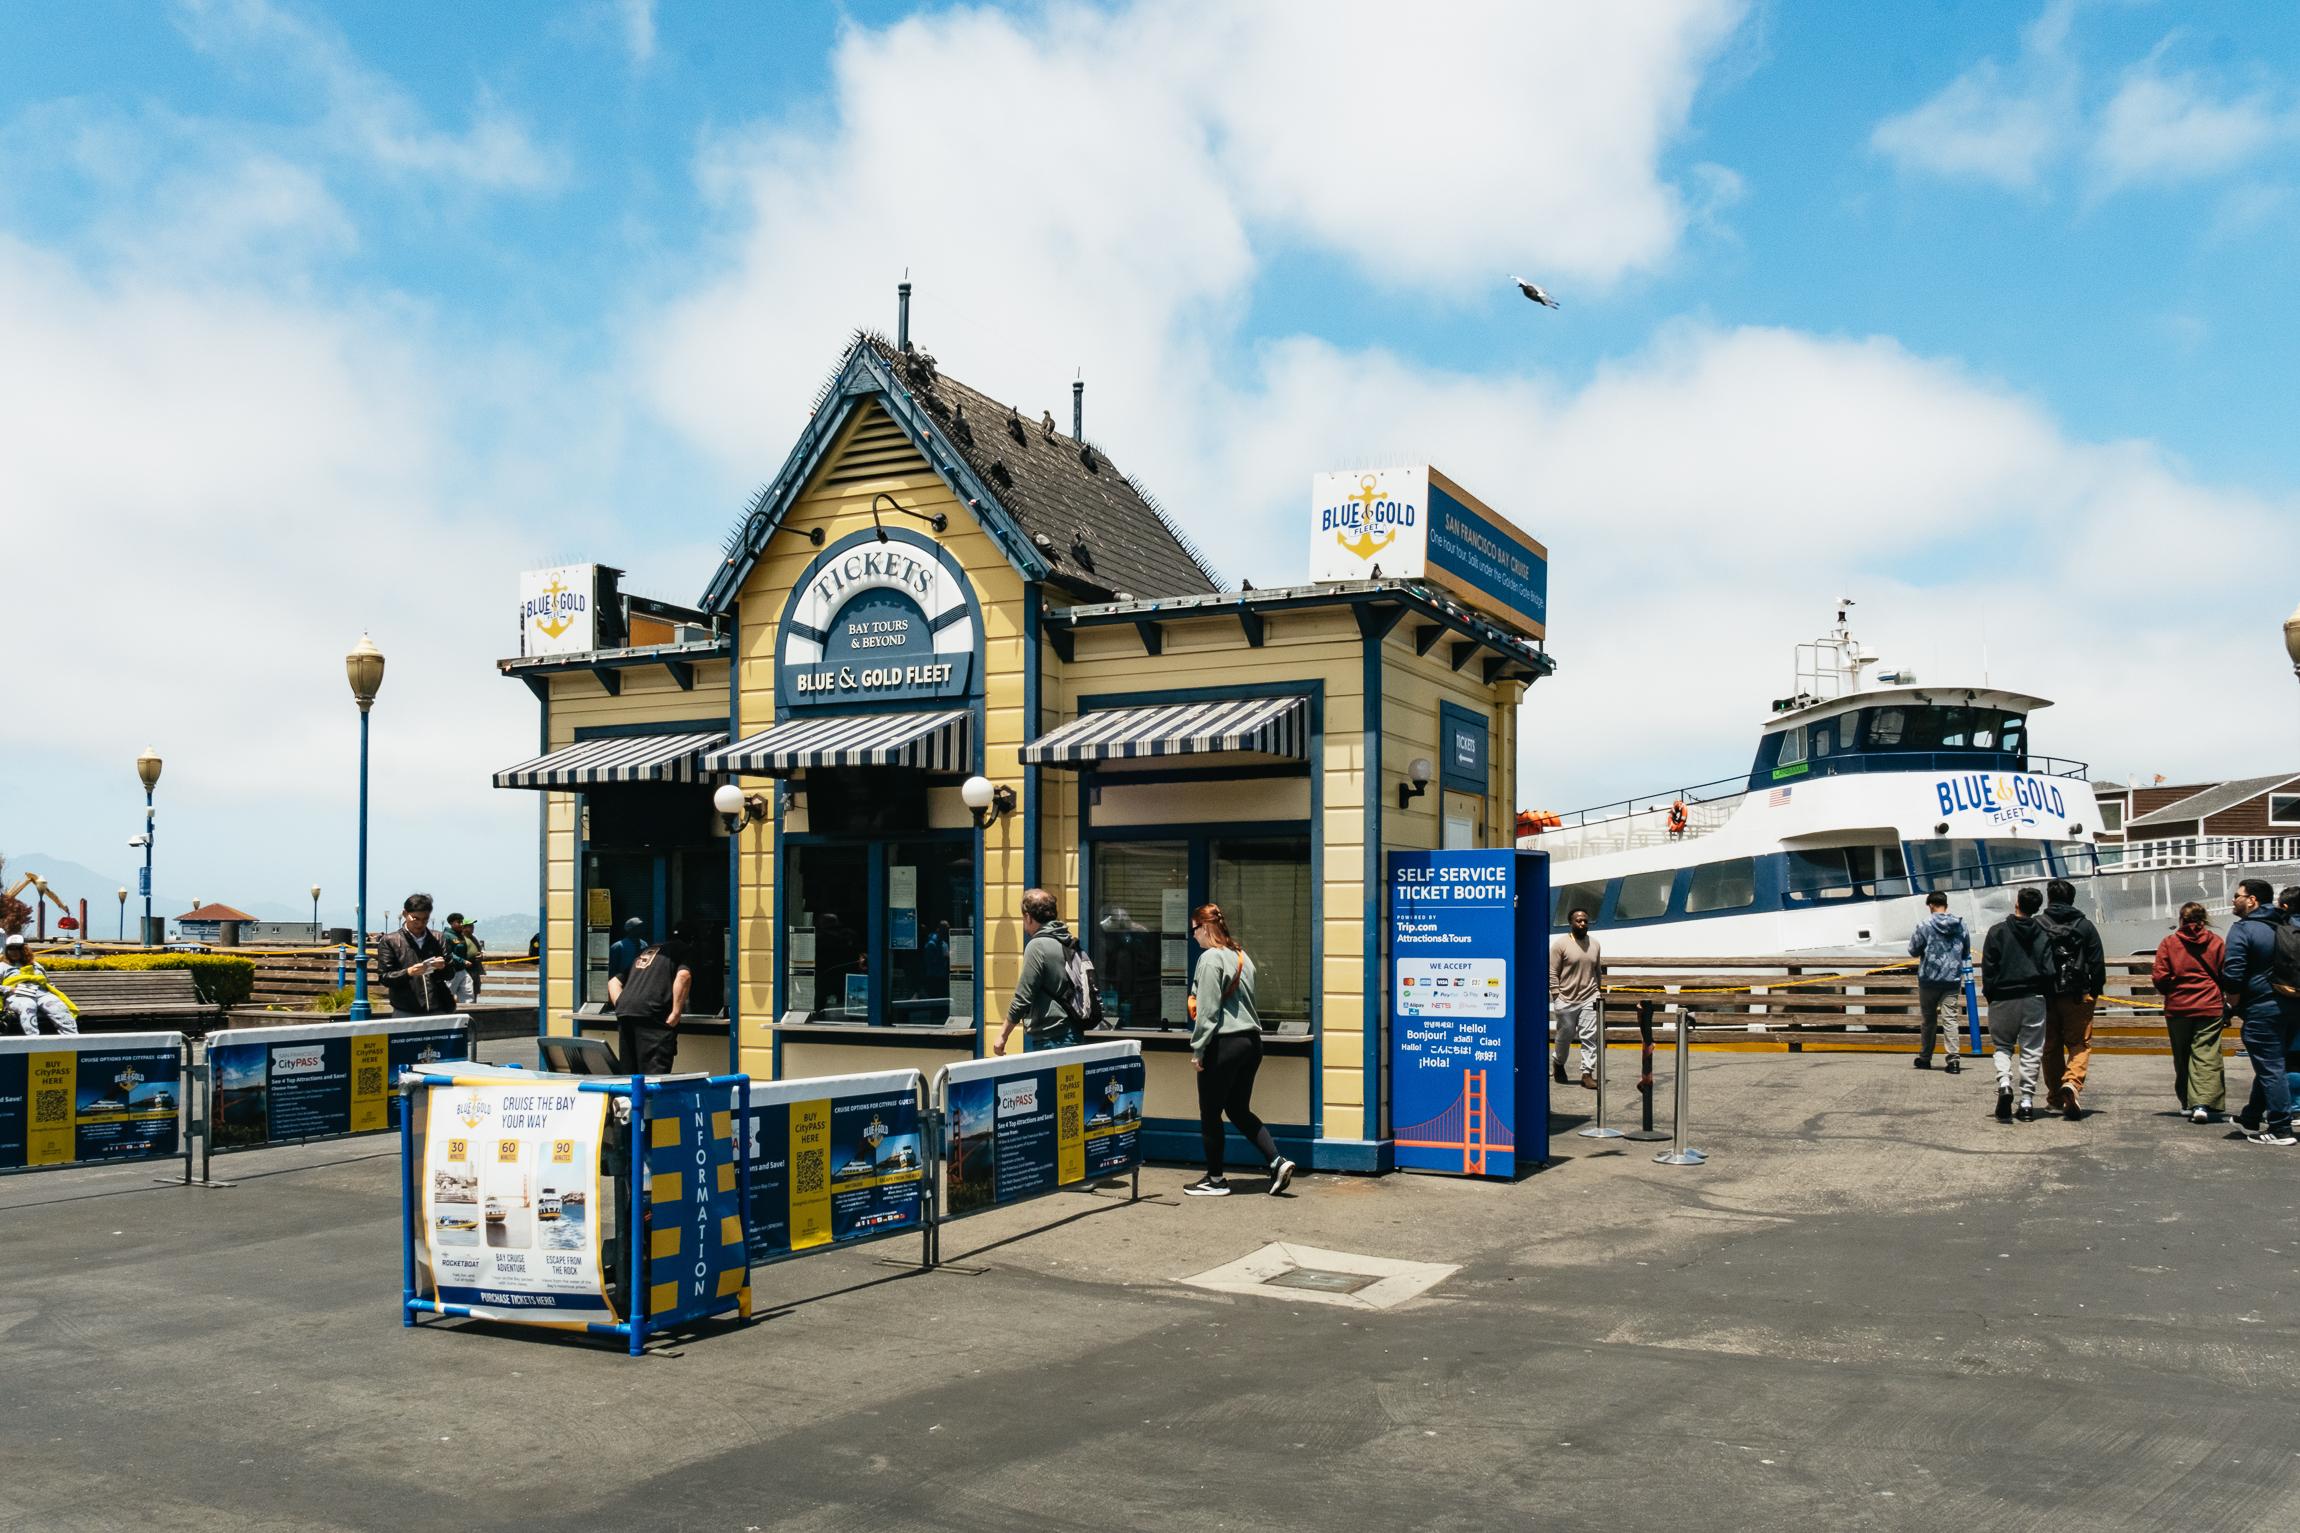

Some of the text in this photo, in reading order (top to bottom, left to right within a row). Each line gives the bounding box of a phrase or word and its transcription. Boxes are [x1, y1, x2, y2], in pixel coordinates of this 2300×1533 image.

[1322, 503, 1360, 531] BLUE
[1375, 501, 1415, 527] GOLD
[1354, 523, 1378, 534] FLEET
[1445, 513, 1529, 580] SAN FRANCISCO BAY CRUISE
[1430, 528, 1442, 547] One
[1443, 537, 1456, 554] hour
[1456, 546, 1467, 562] tour.
[1468, 551, 1479, 569] Sails
[1480, 561, 1493, 577] under
[1502, 573, 1519, 592] Golden
[1519, 584, 1530, 600] Gate
[813, 551, 934, 603] TICKETS
[527, 595, 550, 618] BLUE
[561, 593, 585, 612] GOLD
[849, 620, 908, 635] BAY TOURS
[851, 634, 906, 649] & BEYOND
[797, 664, 952, 692] BLUE & GOLD FLEET
[1456, 734, 1475, 753] TICKETS
[1937, 775, 2065, 818] BLUE & GOLD
[1994, 808, 2024, 823] FLEET
[1397, 867, 1506, 882] SELF SERVICE
[1397, 885, 1506, 900] TICKET BOOTH
[1397, 922, 1437, 933] Trip.com
[1397, 934, 1472, 943] Attractions&Tours
[1459, 1024, 1487, 1033] Hello!
[1407, 1030, 1447, 1041] Bonjour!
[1480, 1038, 1501, 1046] Ciao!
[278, 1057, 318, 1070] CityPASS
[1419, 1057, 1450, 1068] ¡Hola!
[35, 1068, 70, 1077] CityPASS
[1066, 1074, 1075, 1082] BUY
[42, 1077, 63, 1085] HERE
[297, 1075, 322, 1083] Attractions
[1060, 1081, 1080, 1092] CityPASS
[1064, 1091, 1076, 1099] HERE
[503, 1096, 576, 1111] CRUISE THE BAY
[834, 1105, 850, 1114] CRUISE
[851, 1102, 869, 1111] OPTIONS
[879, 1100, 897, 1109] CITYPASS
[1002, 1094, 1033, 1110] CityPASS
[457, 1102, 491, 1115] BLUE GOLD
[502, 1114, 548, 1129] YOUR WAY
[804, 1112, 817, 1122] BUY
[795, 1120, 825, 1133] CityPASS
[864, 1124, 889, 1138] BLUE GOLD
[801, 1134, 819, 1144] HERE
[451, 1142, 464, 1152] 30
[502, 1142, 515, 1153] 60
[556, 1142, 570, 1153] 90
[759, 1162, 769, 1171] and
[770, 1160, 785, 1169] Save!
[695, 1093, 708, 1297] INFORMATION
[496, 1253, 525, 1263] BAY CRUISE
[546, 1256, 582, 1265] ESCAPE FROM
[442, 1260, 479, 1268] ROCKETBOAT
[497, 1264, 526, 1273] ADVENTURE
[552, 1266, 577, 1275] THE ROCK
[481, 1292, 556, 1306] PURCHASE TICKETS HERE!
